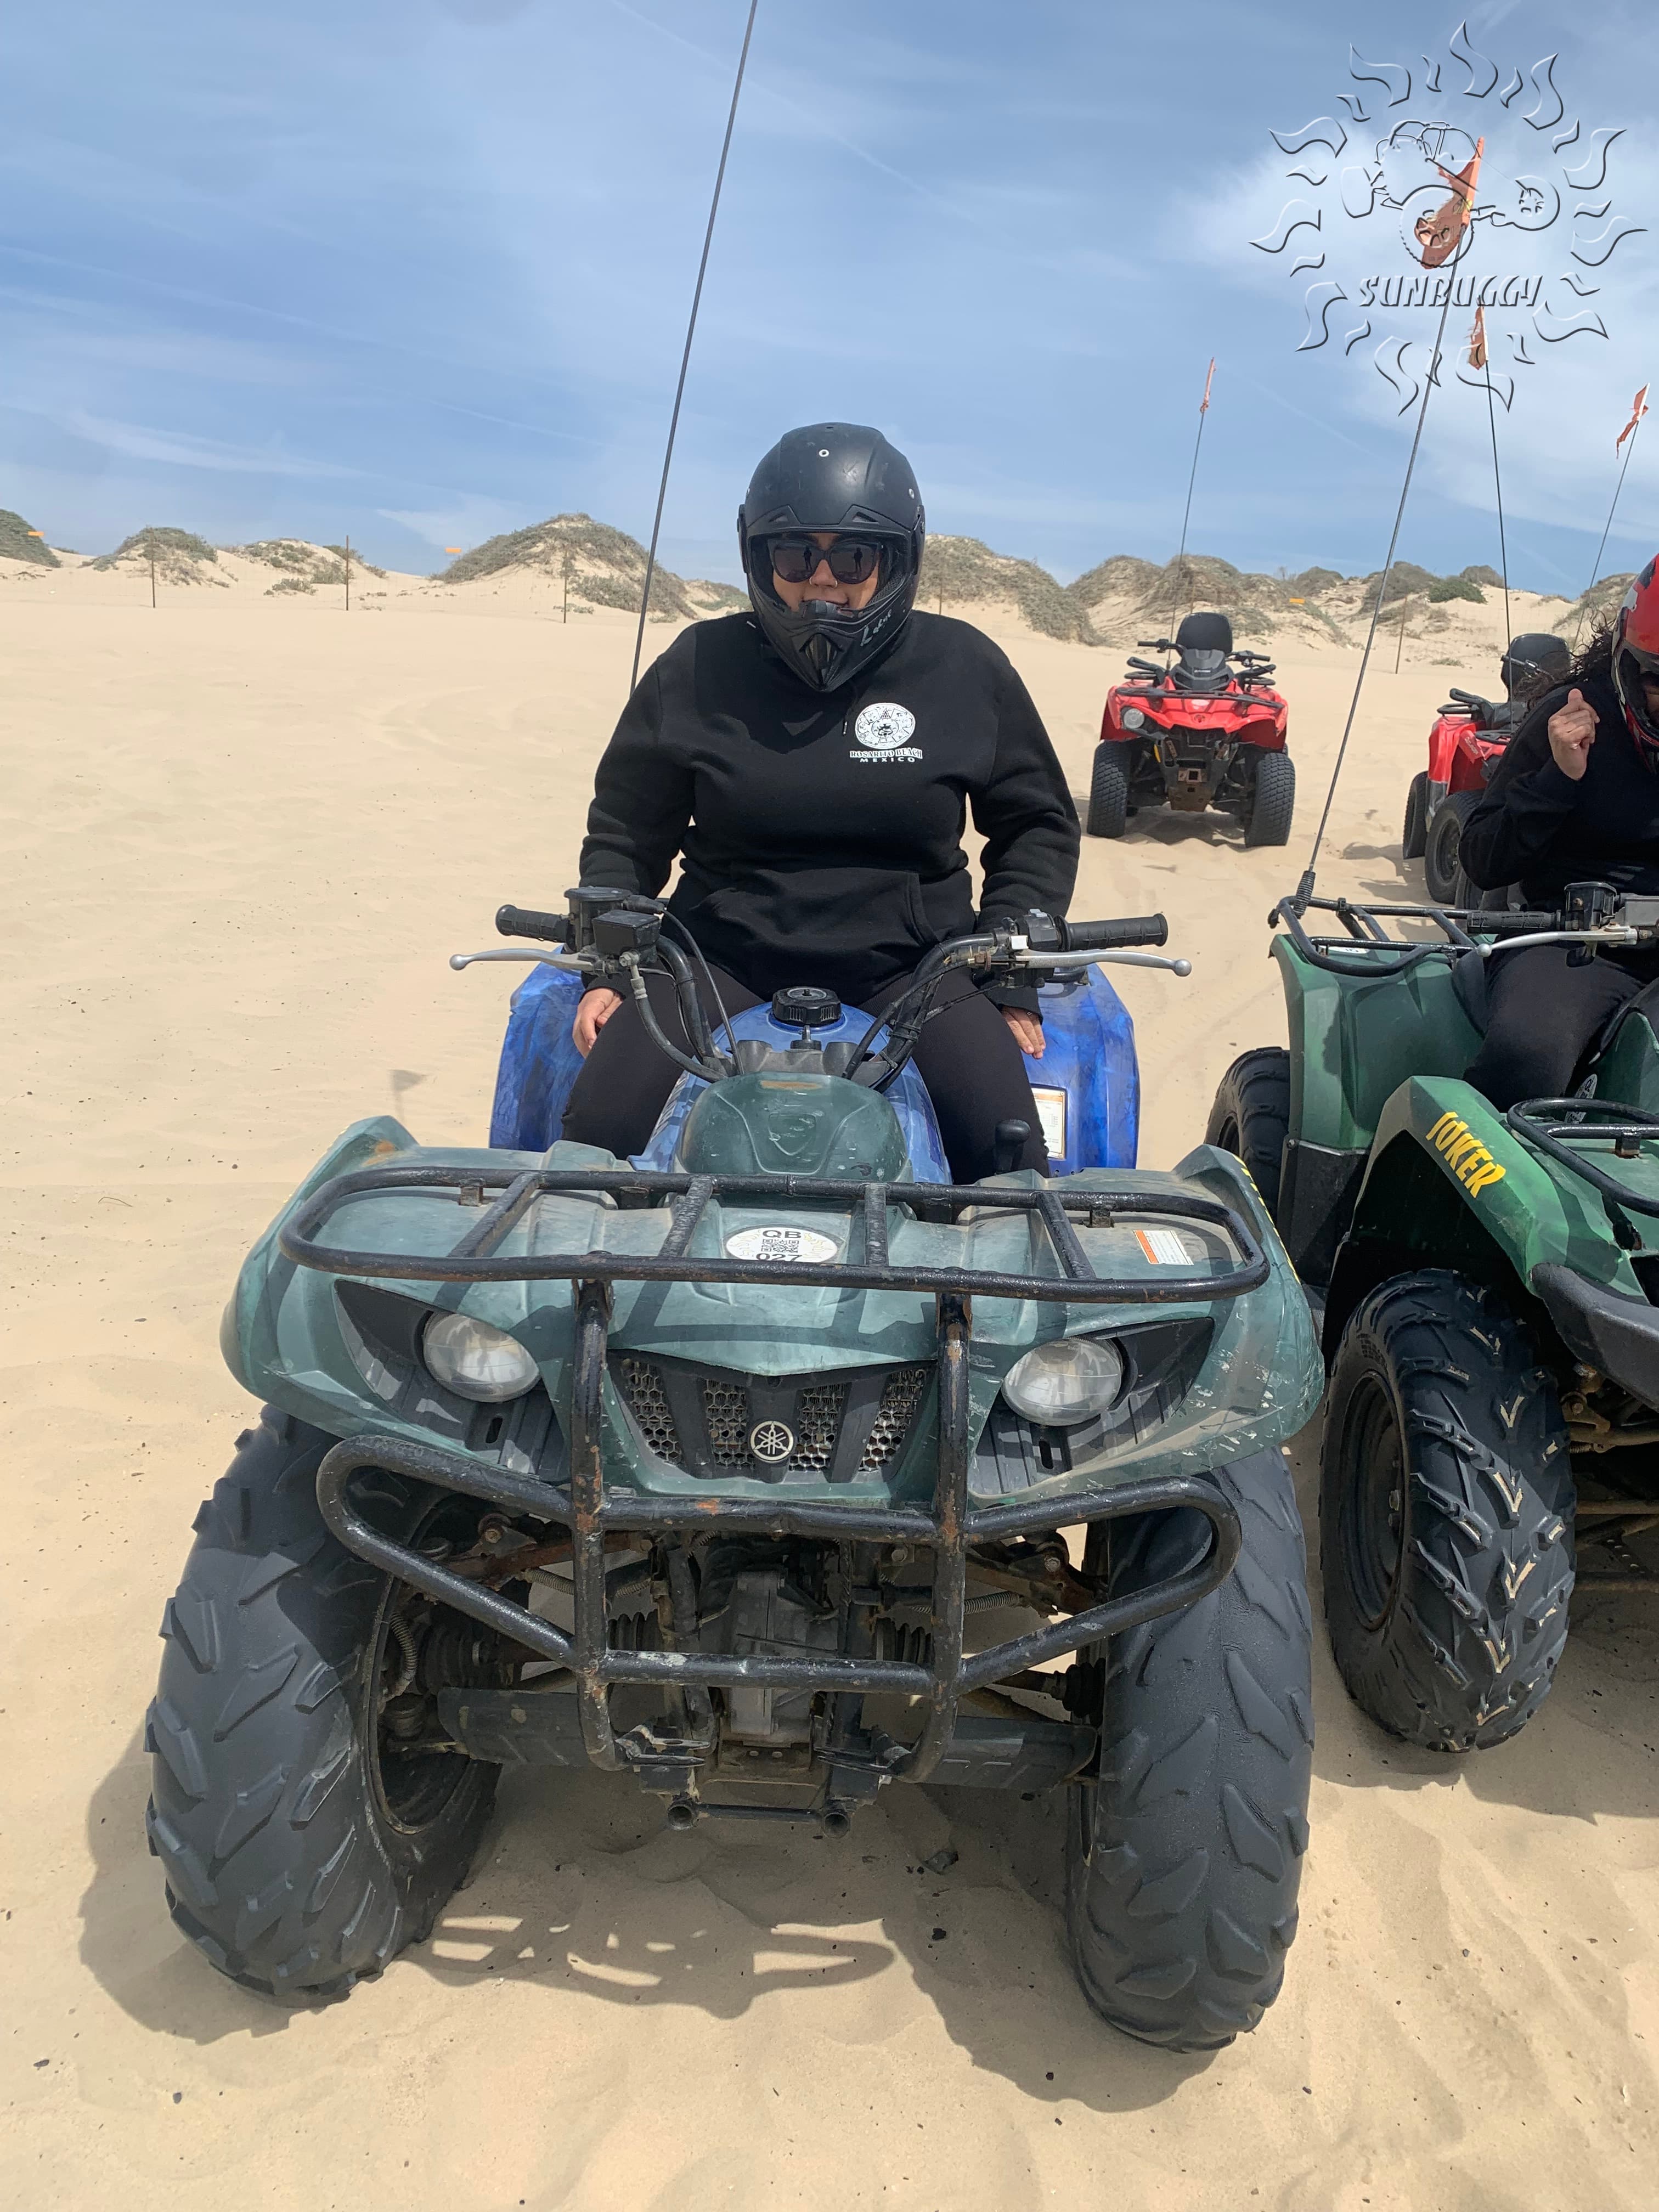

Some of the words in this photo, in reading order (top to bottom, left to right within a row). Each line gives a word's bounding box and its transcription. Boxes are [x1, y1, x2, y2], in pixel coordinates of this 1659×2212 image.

[850, 750, 895, 758] ROSARITO
[895, 747, 923, 759] BEACH
[762, 1229, 802, 1239] QB
[755, 1252, 803, 1262] 027
